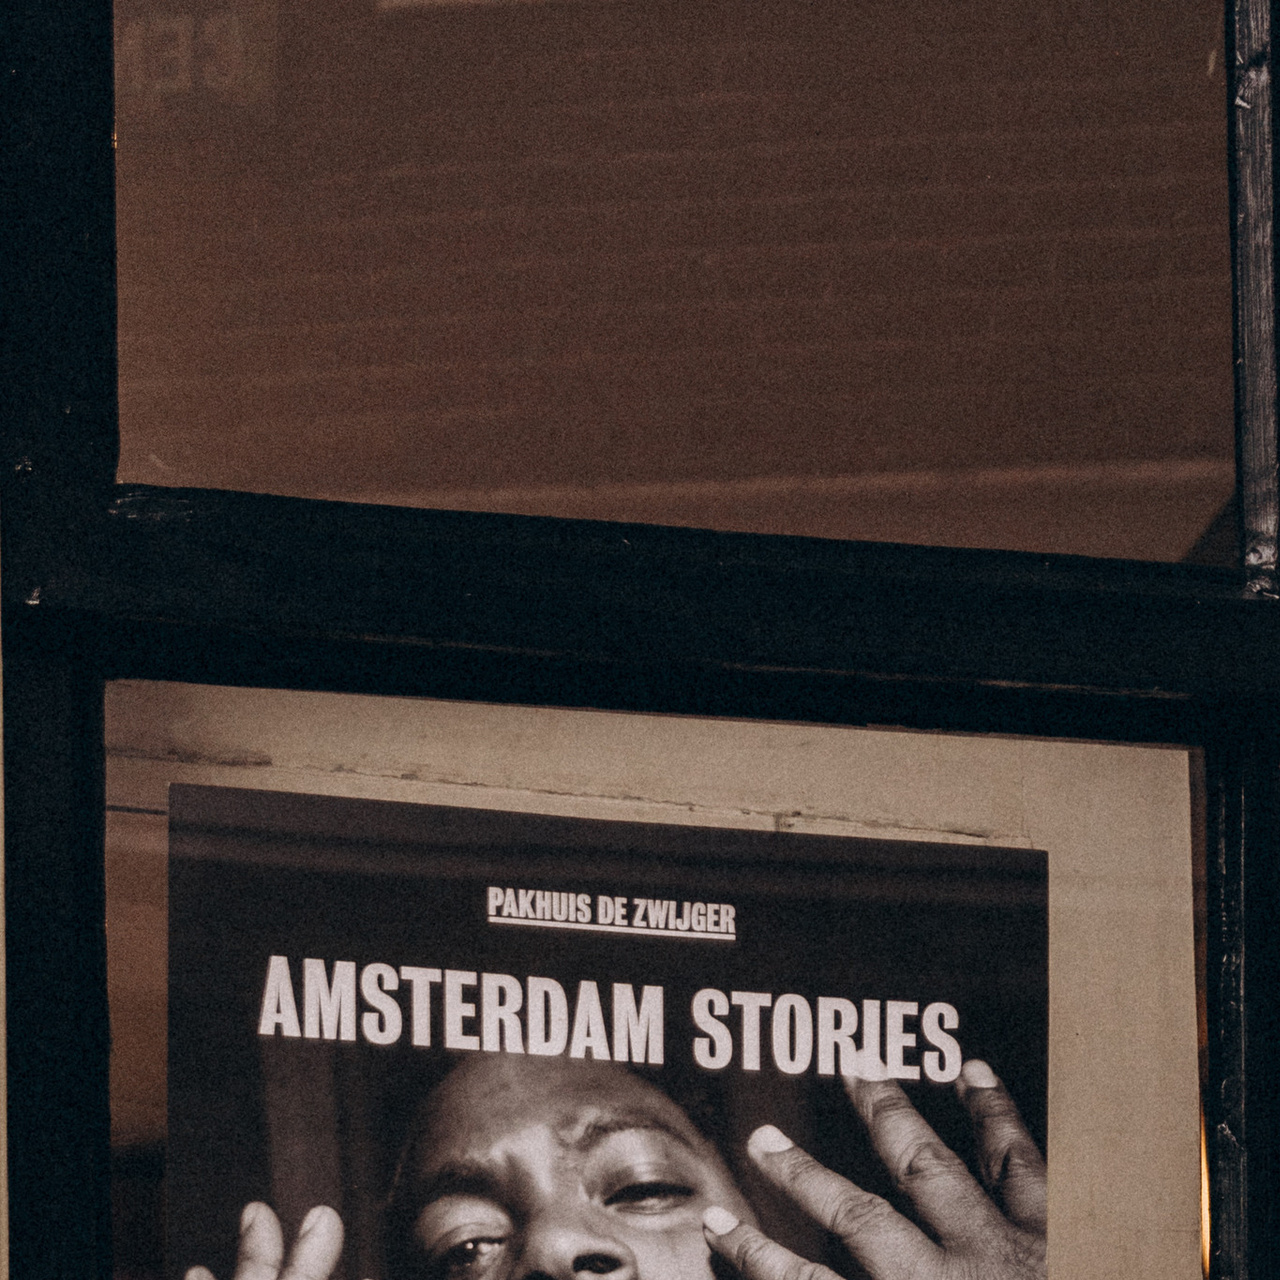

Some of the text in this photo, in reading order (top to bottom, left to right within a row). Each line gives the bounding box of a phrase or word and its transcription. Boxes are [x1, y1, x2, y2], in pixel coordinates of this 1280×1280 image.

[487, 887, 736, 935] PAKHUIS DE ZWIJGER
[258, 956, 962, 1083] AMSTERDAM STORIES
